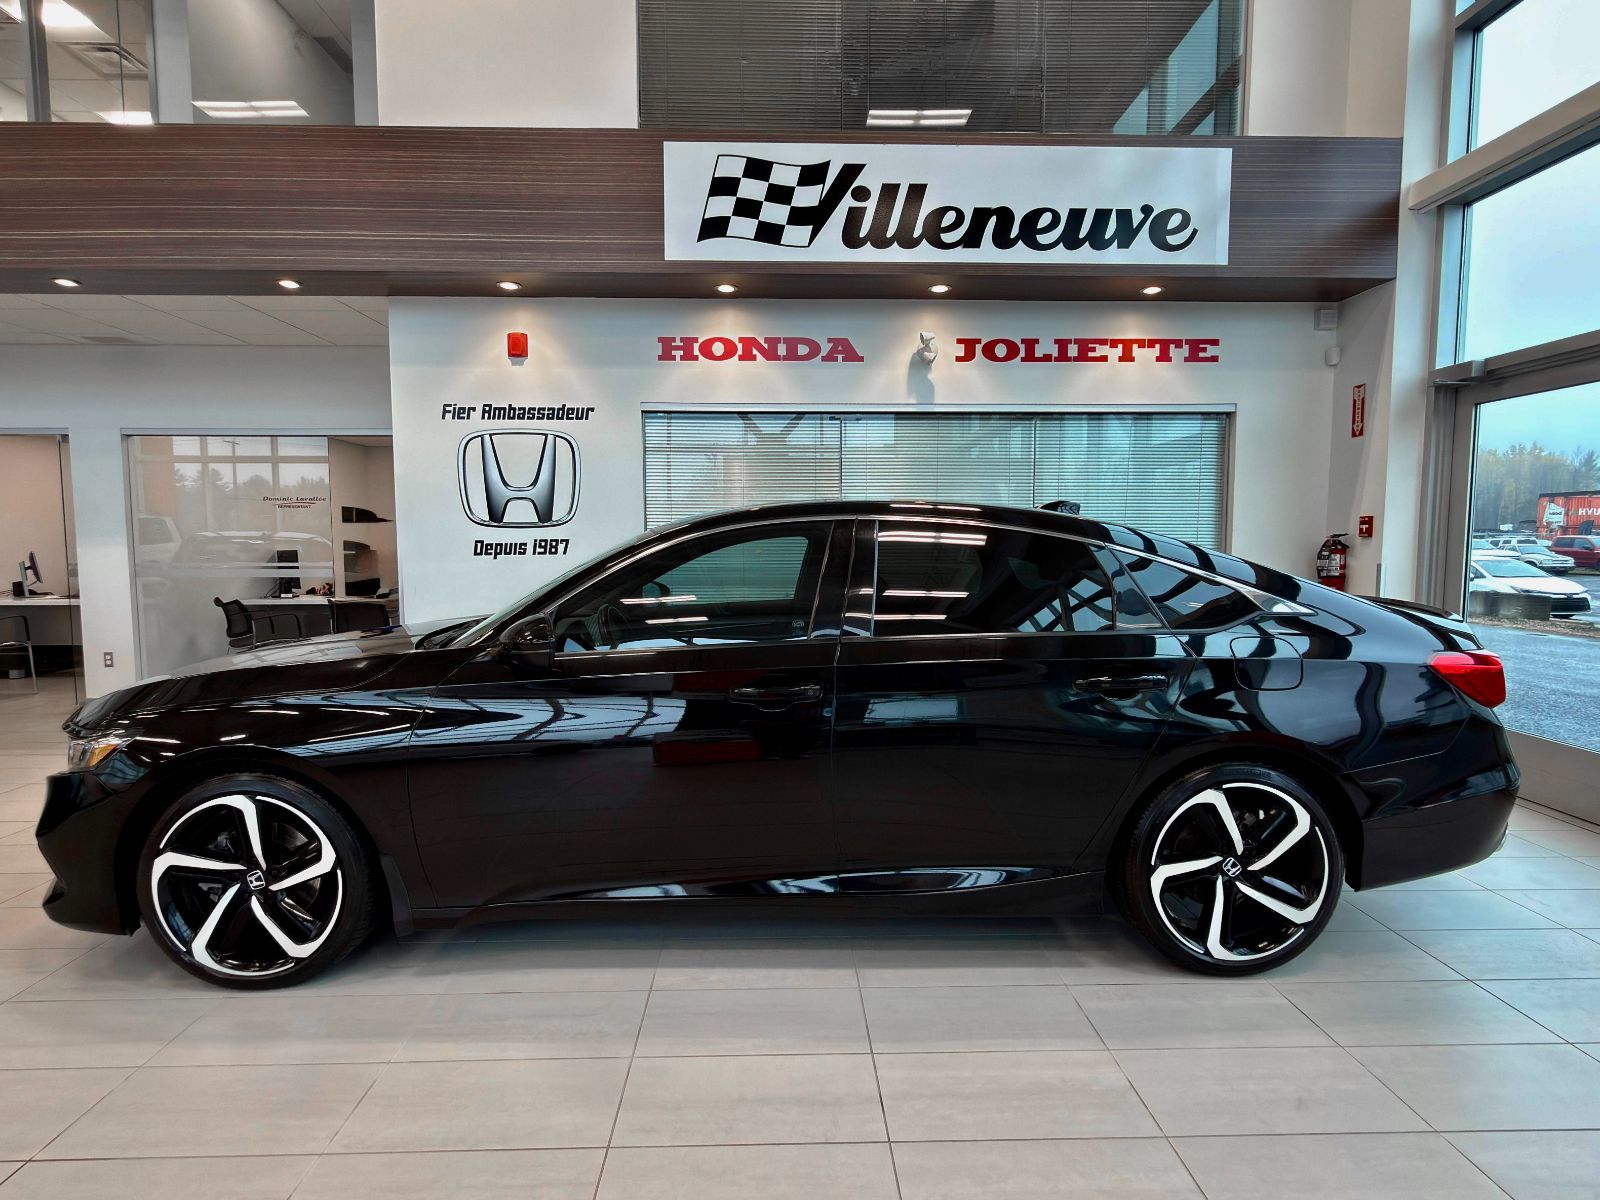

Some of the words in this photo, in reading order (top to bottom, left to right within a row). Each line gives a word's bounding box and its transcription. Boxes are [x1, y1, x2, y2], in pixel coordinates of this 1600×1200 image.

[798, 163, 1200, 253] Villeneuve
[657, 336, 865, 363] HONDA
[955, 337, 1220, 363] JOLIETTE
[441, 403, 477, 420] Fier
[480, 403, 596, 421] Ambassadeur
[473, 539, 528, 560] Depuis
[532, 538, 570, 556] 1987
